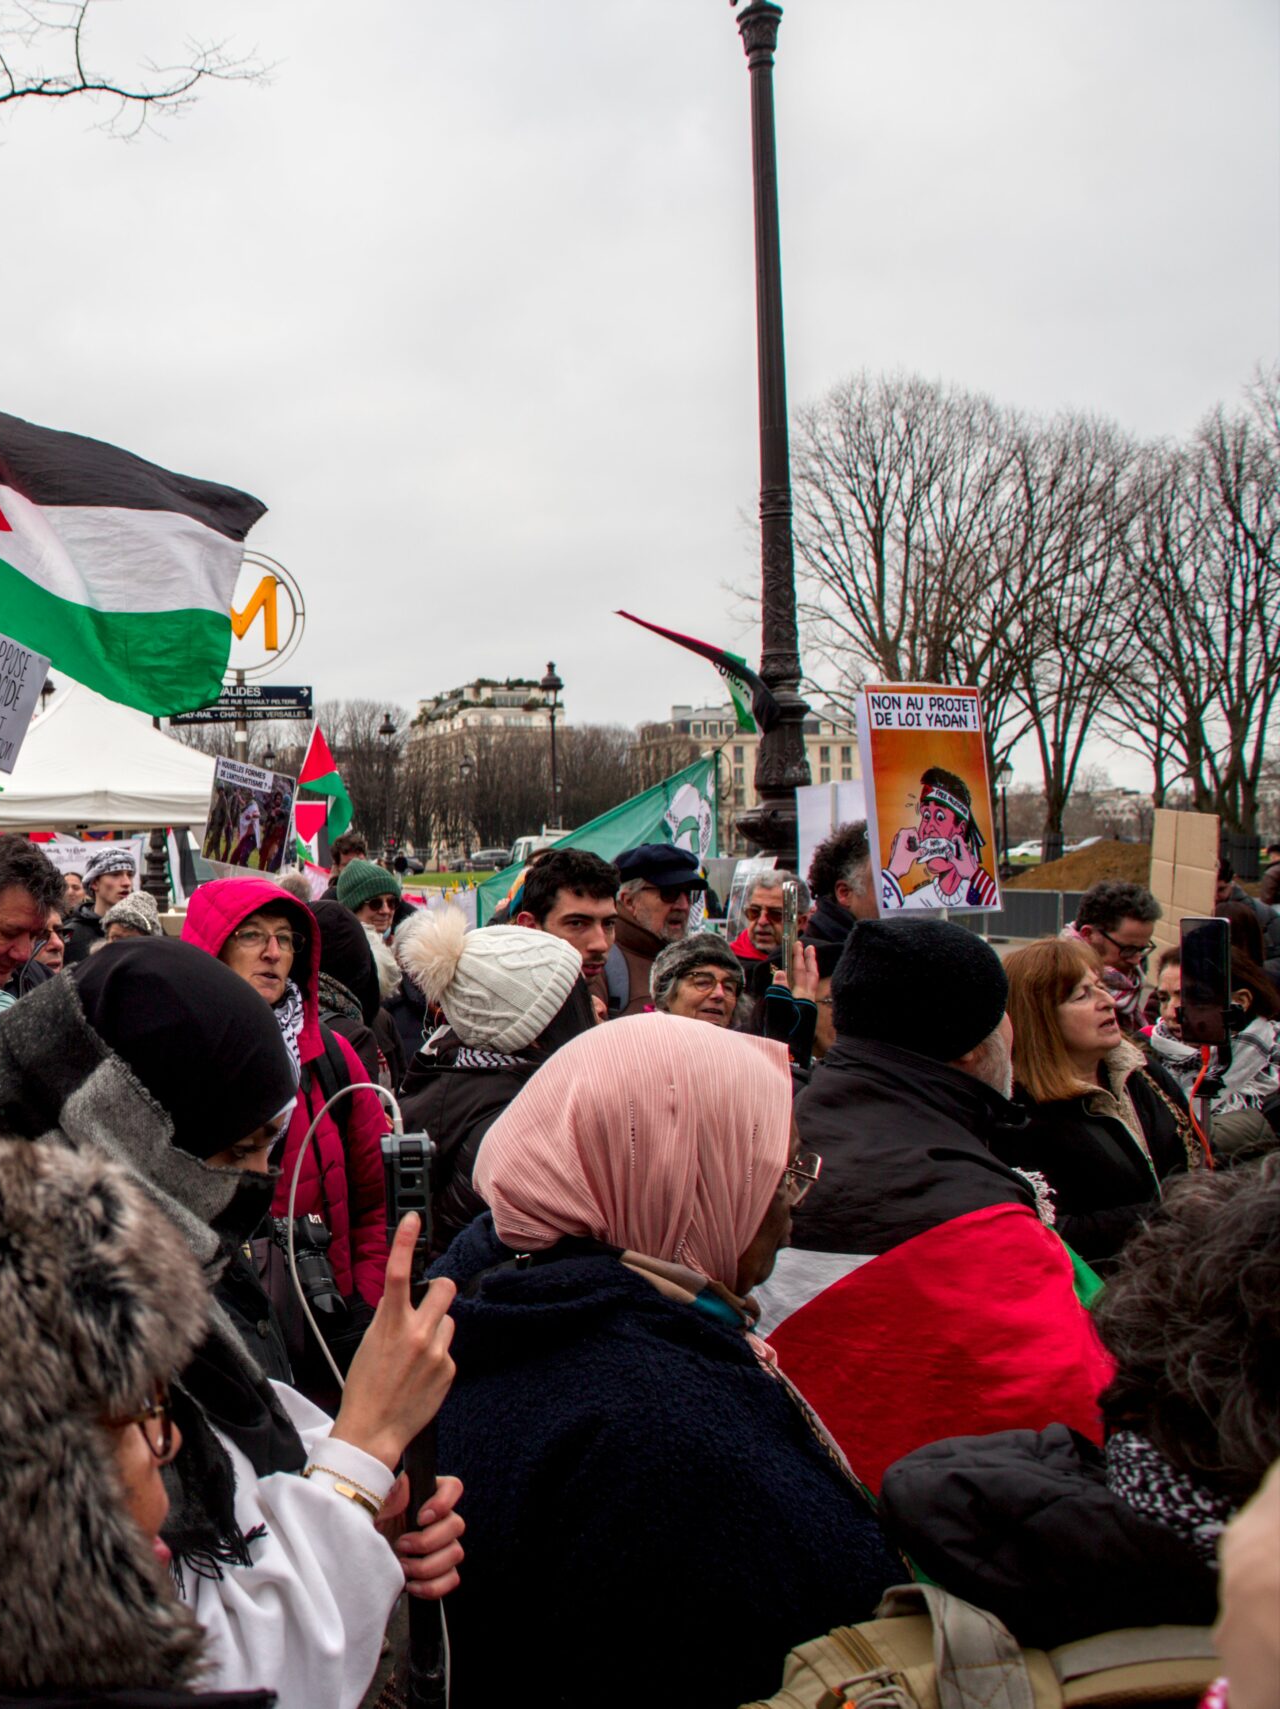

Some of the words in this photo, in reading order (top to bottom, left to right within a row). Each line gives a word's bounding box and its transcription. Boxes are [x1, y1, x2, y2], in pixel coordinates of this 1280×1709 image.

[220, 686, 261, 697] ALIDES
[871, 695, 902, 710] NON
[906, 696, 924, 711] AU
[929, 697, 976, 713] PROJET
[265, 710, 307, 718] VERSAILLES
[875, 712, 893, 726] DE
[898, 713, 922, 727] LOI
[925, 713, 969, 729] YADAN
[972, 715, 978, 729] !
[220, 769, 226, 778] DE
[221, 760, 245, 774] NOUVELLES
[245, 768, 266, 780] FORMES
